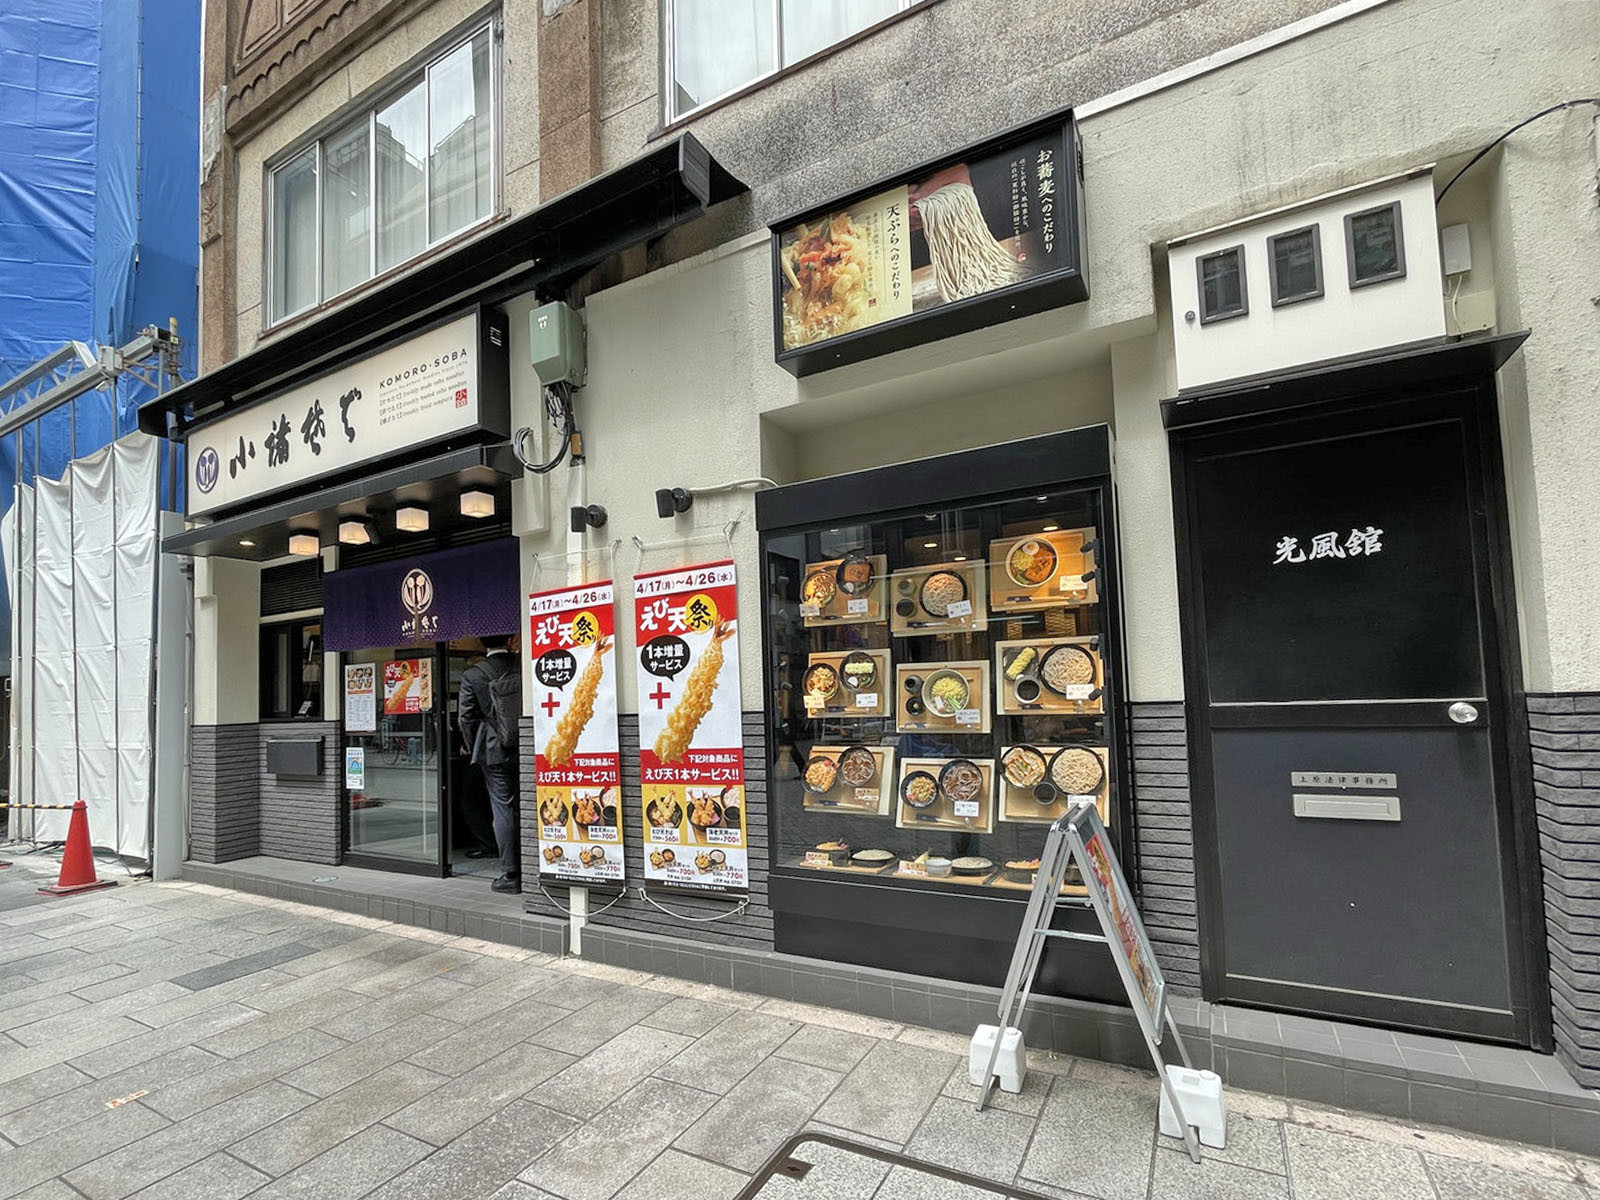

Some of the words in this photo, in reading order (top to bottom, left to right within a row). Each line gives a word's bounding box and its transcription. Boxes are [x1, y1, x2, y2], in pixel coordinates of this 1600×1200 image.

[1036, 149, 1056, 254] お蕎麦へのこだわり
[886, 203, 901, 300] 天ぷらへのこだわり
[1272, 526, 1384, 565] 光風館
[646, 643, 685, 660] 1本増量
[539, 656, 573, 672] 1本増量
[649, 659, 683, 672] サービス
[541, 670, 571, 683] サービス
